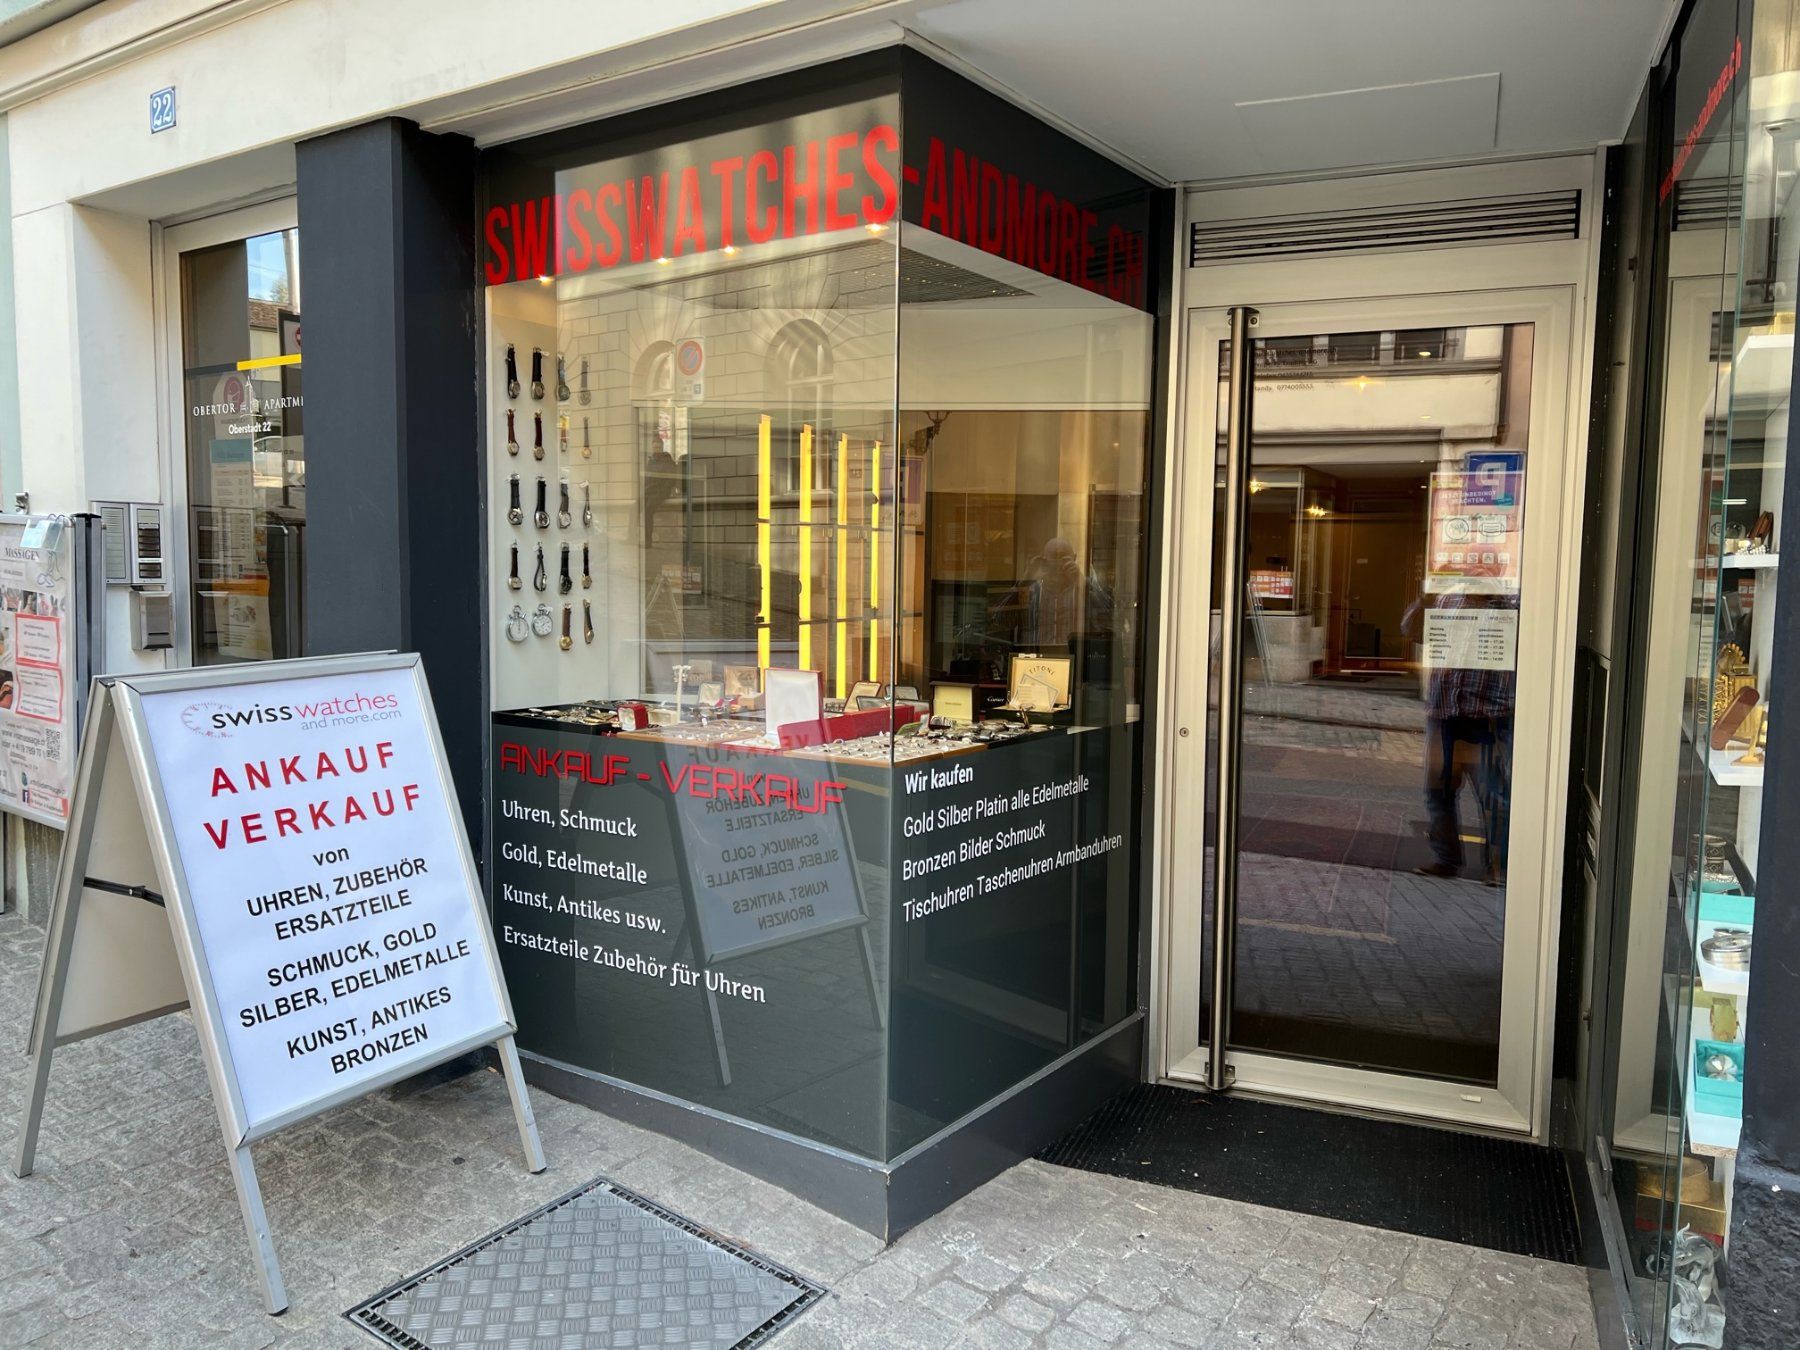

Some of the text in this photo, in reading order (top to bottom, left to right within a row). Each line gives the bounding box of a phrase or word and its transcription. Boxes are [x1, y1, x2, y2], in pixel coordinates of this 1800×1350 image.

[153, 94, 172, 126] 22
[193, 402, 236, 417] OBERTOR
[228, 421, 272, 434] Oberstadt 22
[1029, 665, 1055, 676] TITONI
[301, 709, 402, 731] and more.com
[210, 741, 395, 798] ANKAUF
[500, 743, 631, 786] ANKAUF
[660, 761, 848, 815] VERKAUF
[905, 763, 974, 795] Wir kaufen
[203, 784, 420, 850] VERKAUF
[502, 799, 638, 839] Uhren, Schmuck
[903, 774, 1090, 838] Gold Silber Platin alle Edelmetalle
[313, 847, 350, 866] von
[502, 842, 648, 885] Gold, Edelmetalle
[902, 819, 1046, 881] Bronzen Bilder Schmuck
[246, 857, 429, 917] UHREN, ZUBEHÖR
[902, 833, 1122, 922] Tischuhren Taschenuhren Armbanduhren
[274, 889, 412, 940] ERSATZTEILE
[503, 884, 667, 935] Kunst, Antikes usw.
[267, 922, 437, 987] SCHMUCK, GOLD
[504, 926, 766, 1003] Ersatzteile Zubehör für Uhren
[239, 940, 470, 1028] SILBER, EDELMETALLE
[286, 986, 452, 1059] KUNST, ANTIKES
[331, 1023, 429, 1074] BRONZEN
